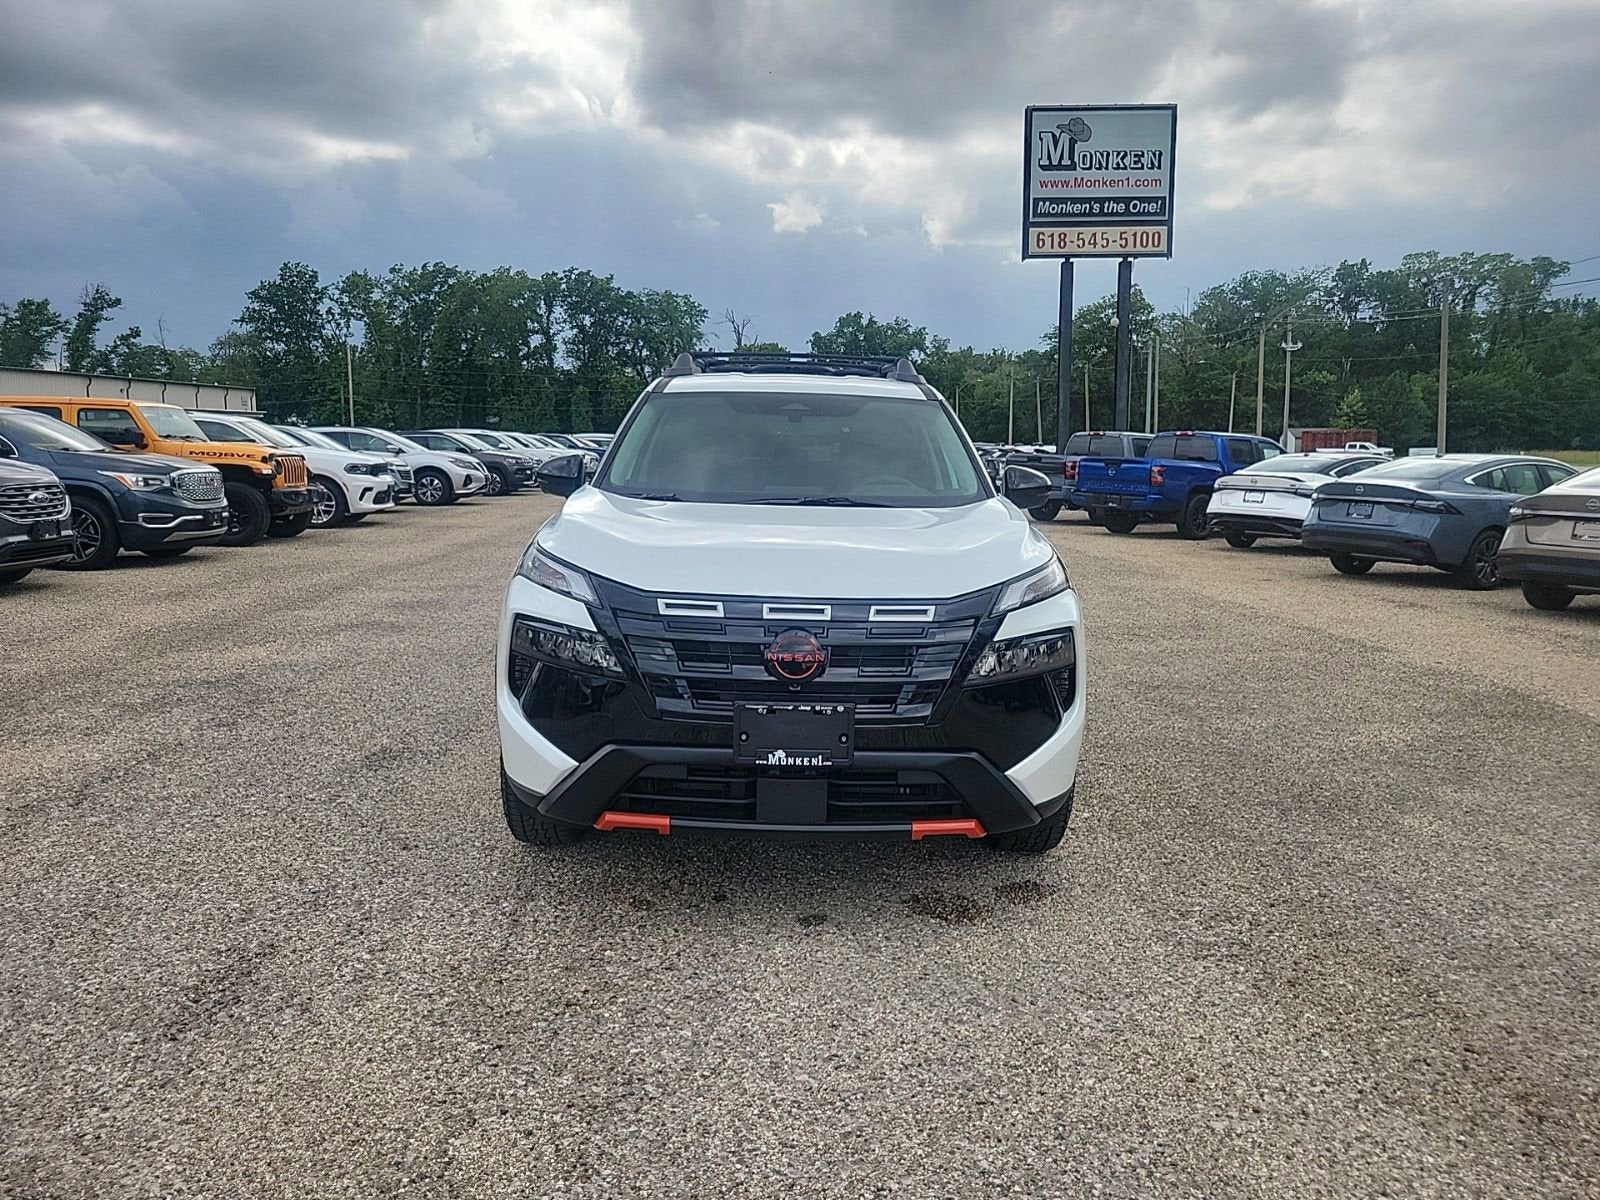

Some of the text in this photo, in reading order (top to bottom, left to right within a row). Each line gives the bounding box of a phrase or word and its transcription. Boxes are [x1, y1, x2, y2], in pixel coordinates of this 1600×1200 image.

[1038, 131, 1163, 171] MONKEN
[1039, 176, 1162, 189] www.Monken1.com
[1037, 199, 1162, 214] Monken's the One!
[1036, 231, 1162, 250] 618-545-5100
[189, 450, 257, 458] MOJAVE
[767, 652, 825, 662] NISSAN
